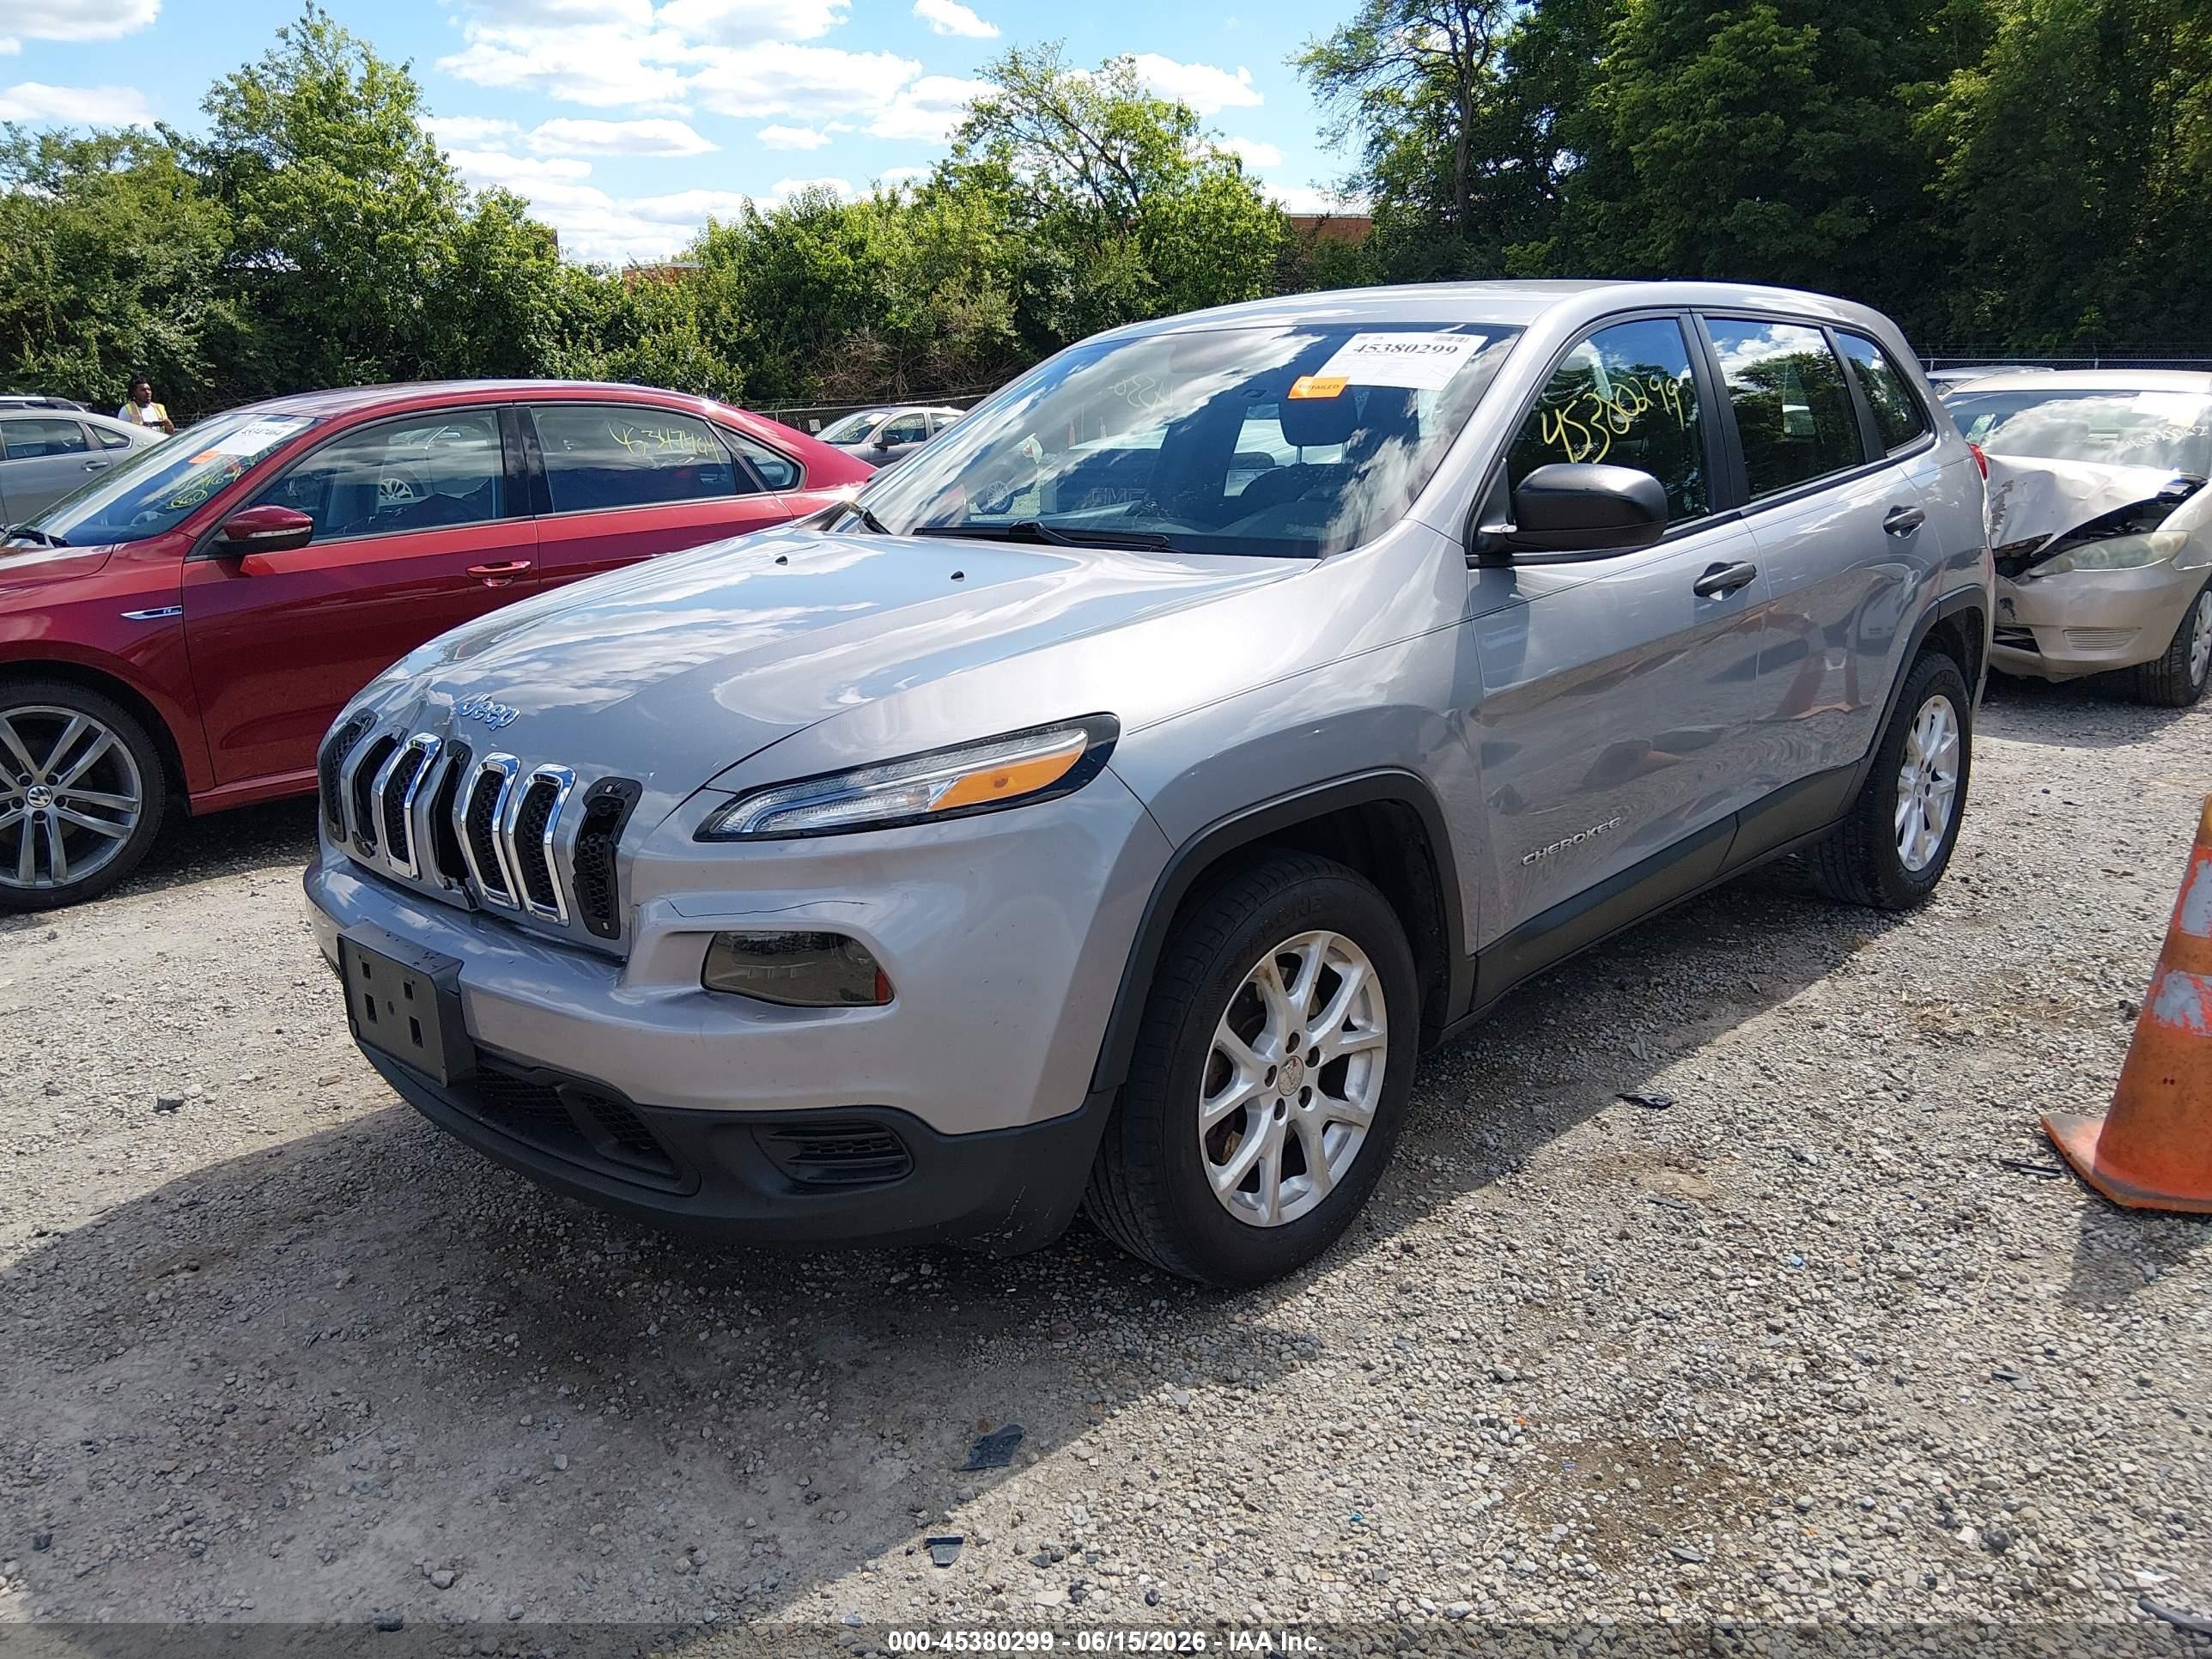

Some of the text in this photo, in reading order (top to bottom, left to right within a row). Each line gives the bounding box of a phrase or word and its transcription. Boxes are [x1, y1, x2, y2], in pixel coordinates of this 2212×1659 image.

[1353, 343, 1459, 356] 45380299
[1541, 376, 1685, 464] 45380299
[455, 693, 521, 731] Jeep
[1522, 817, 1622, 866] CHEROKEE
